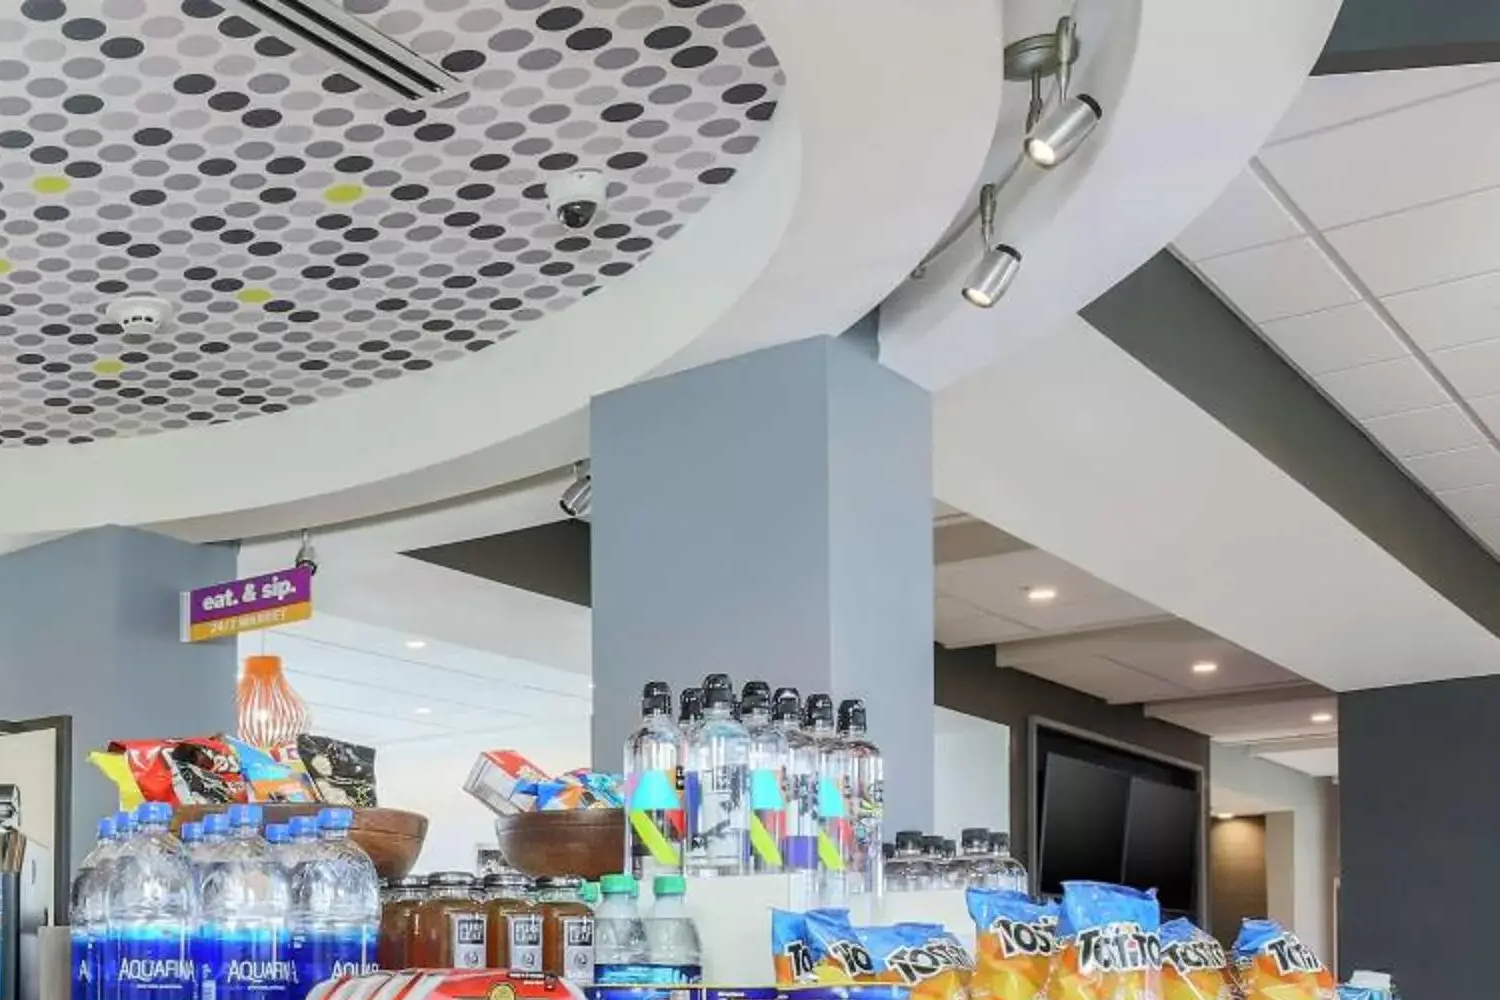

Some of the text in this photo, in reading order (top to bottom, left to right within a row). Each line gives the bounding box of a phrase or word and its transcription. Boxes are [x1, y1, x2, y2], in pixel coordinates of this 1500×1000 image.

[202, 576, 297, 610] eat. & sip.
[118, 956, 198, 982] AQUAFINA
[227, 957, 299, 984] AQUAFINA
